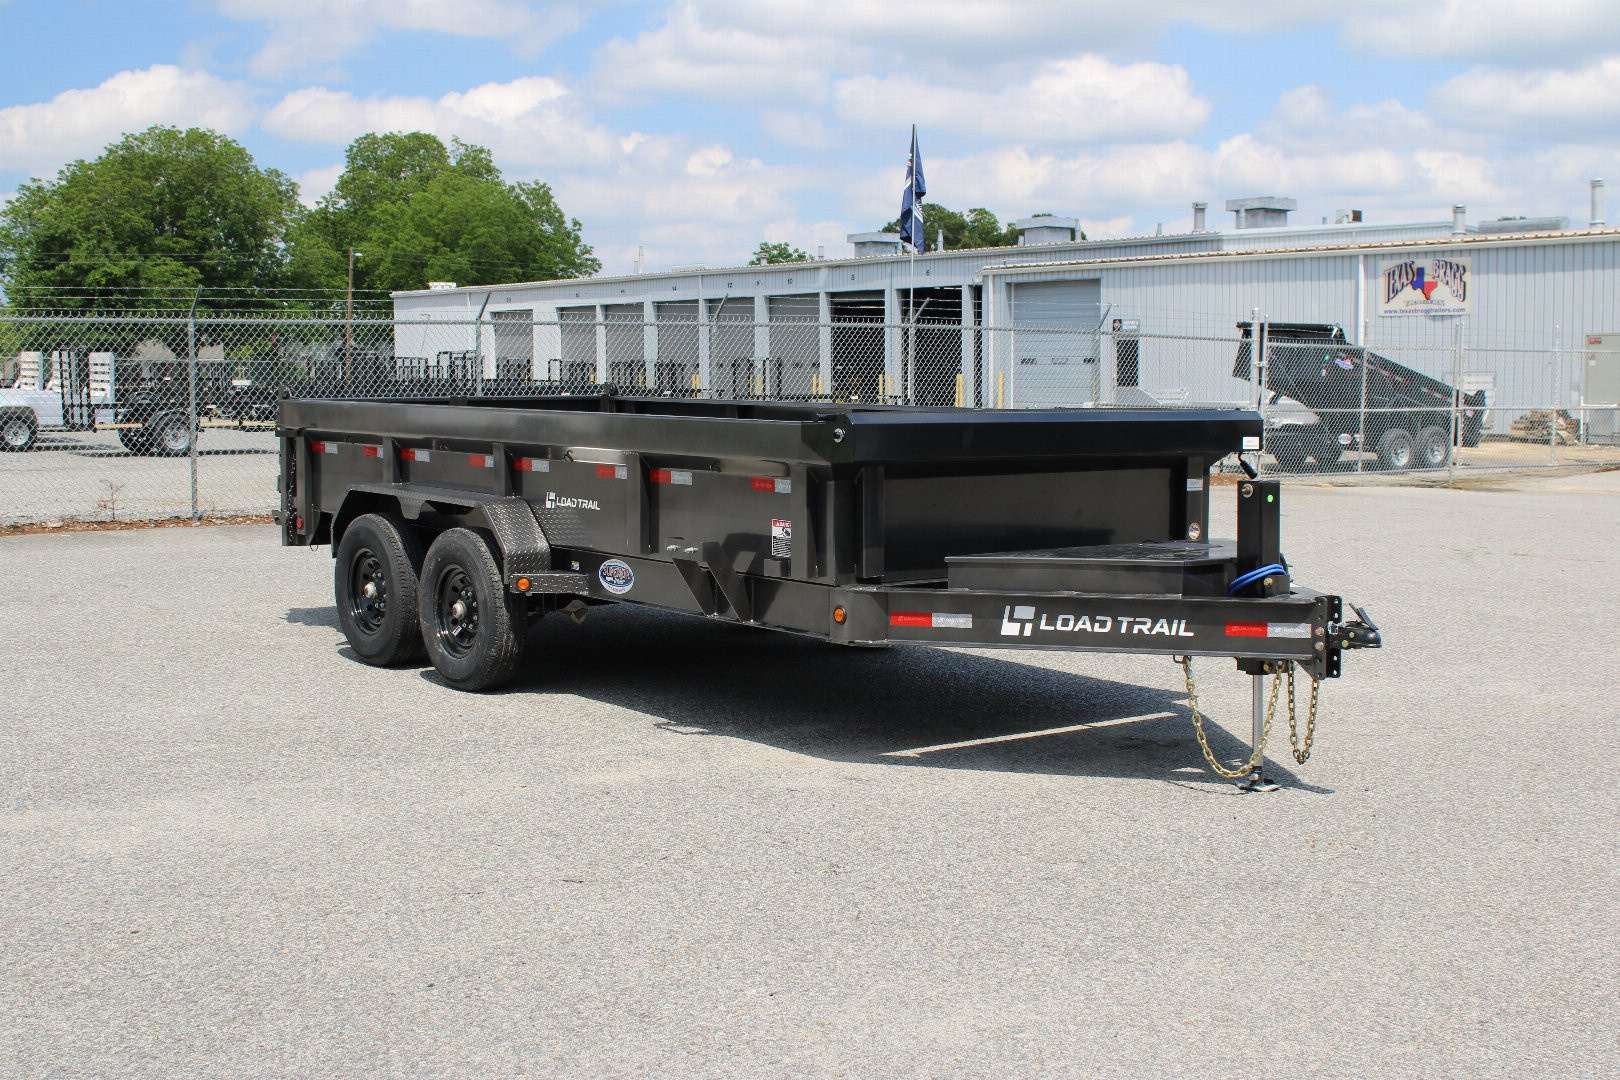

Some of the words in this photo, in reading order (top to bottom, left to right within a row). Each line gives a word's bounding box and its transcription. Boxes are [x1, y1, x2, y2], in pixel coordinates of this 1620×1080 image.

[1384, 260, 1416, 304] TEXAS
[1433, 259, 1466, 303] BRAGG
[556, 496, 577, 508] LOAD
[577, 498, 600, 511] TRAIL
[1039, 613, 1112, 633] LOAD
[1117, 616, 1195, 637] TRAIL
